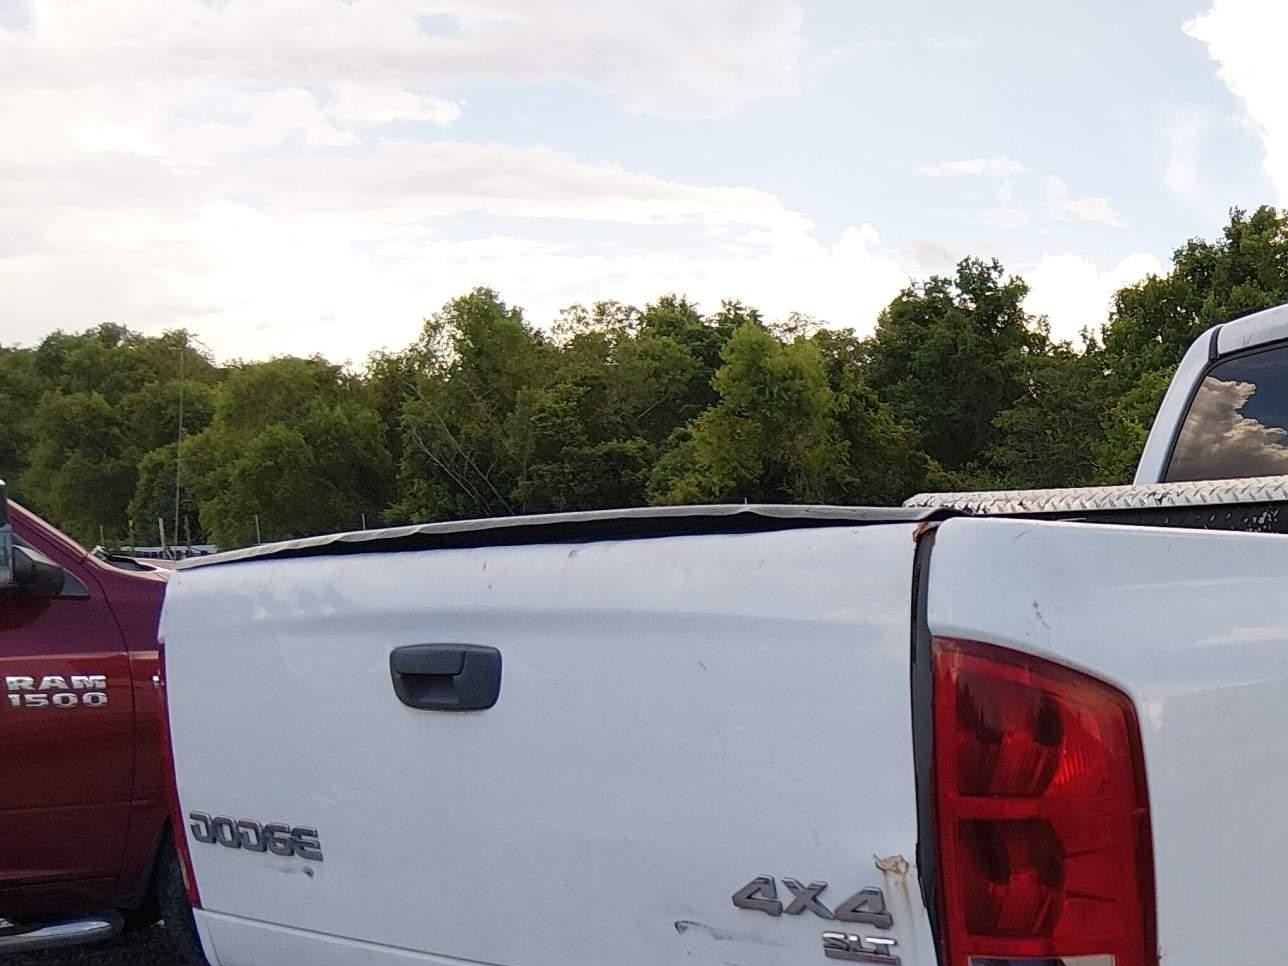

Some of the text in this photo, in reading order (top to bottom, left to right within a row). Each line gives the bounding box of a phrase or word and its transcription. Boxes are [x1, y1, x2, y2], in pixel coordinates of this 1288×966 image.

[5, 674, 107, 691] RAM
[7, 691, 108, 709] 1500
[189, 810, 324, 861] DODGE
[821, 931, 899, 960] SLT
